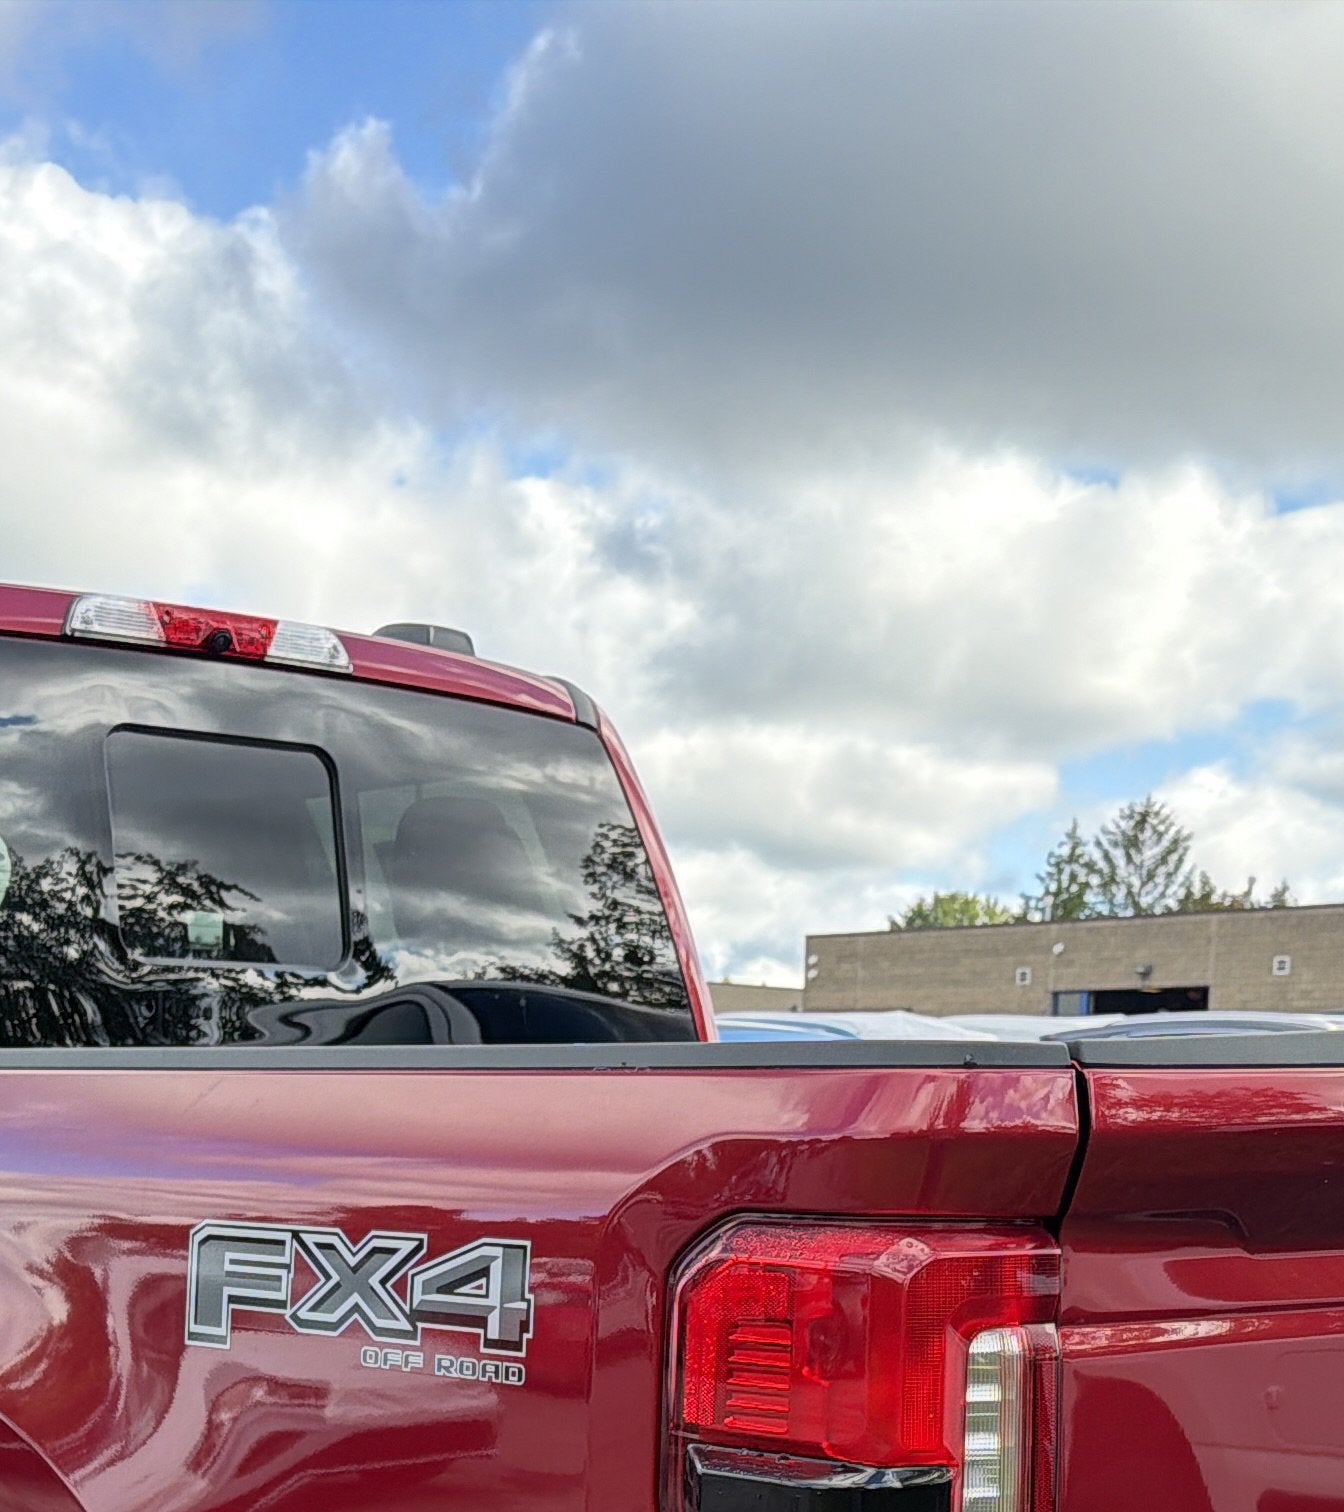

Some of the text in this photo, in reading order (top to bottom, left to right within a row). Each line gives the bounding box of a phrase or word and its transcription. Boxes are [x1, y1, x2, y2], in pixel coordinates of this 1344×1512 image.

[185, 1219, 534, 1357] FX4
[361, 1346, 526, 1387] OFF ROAD
